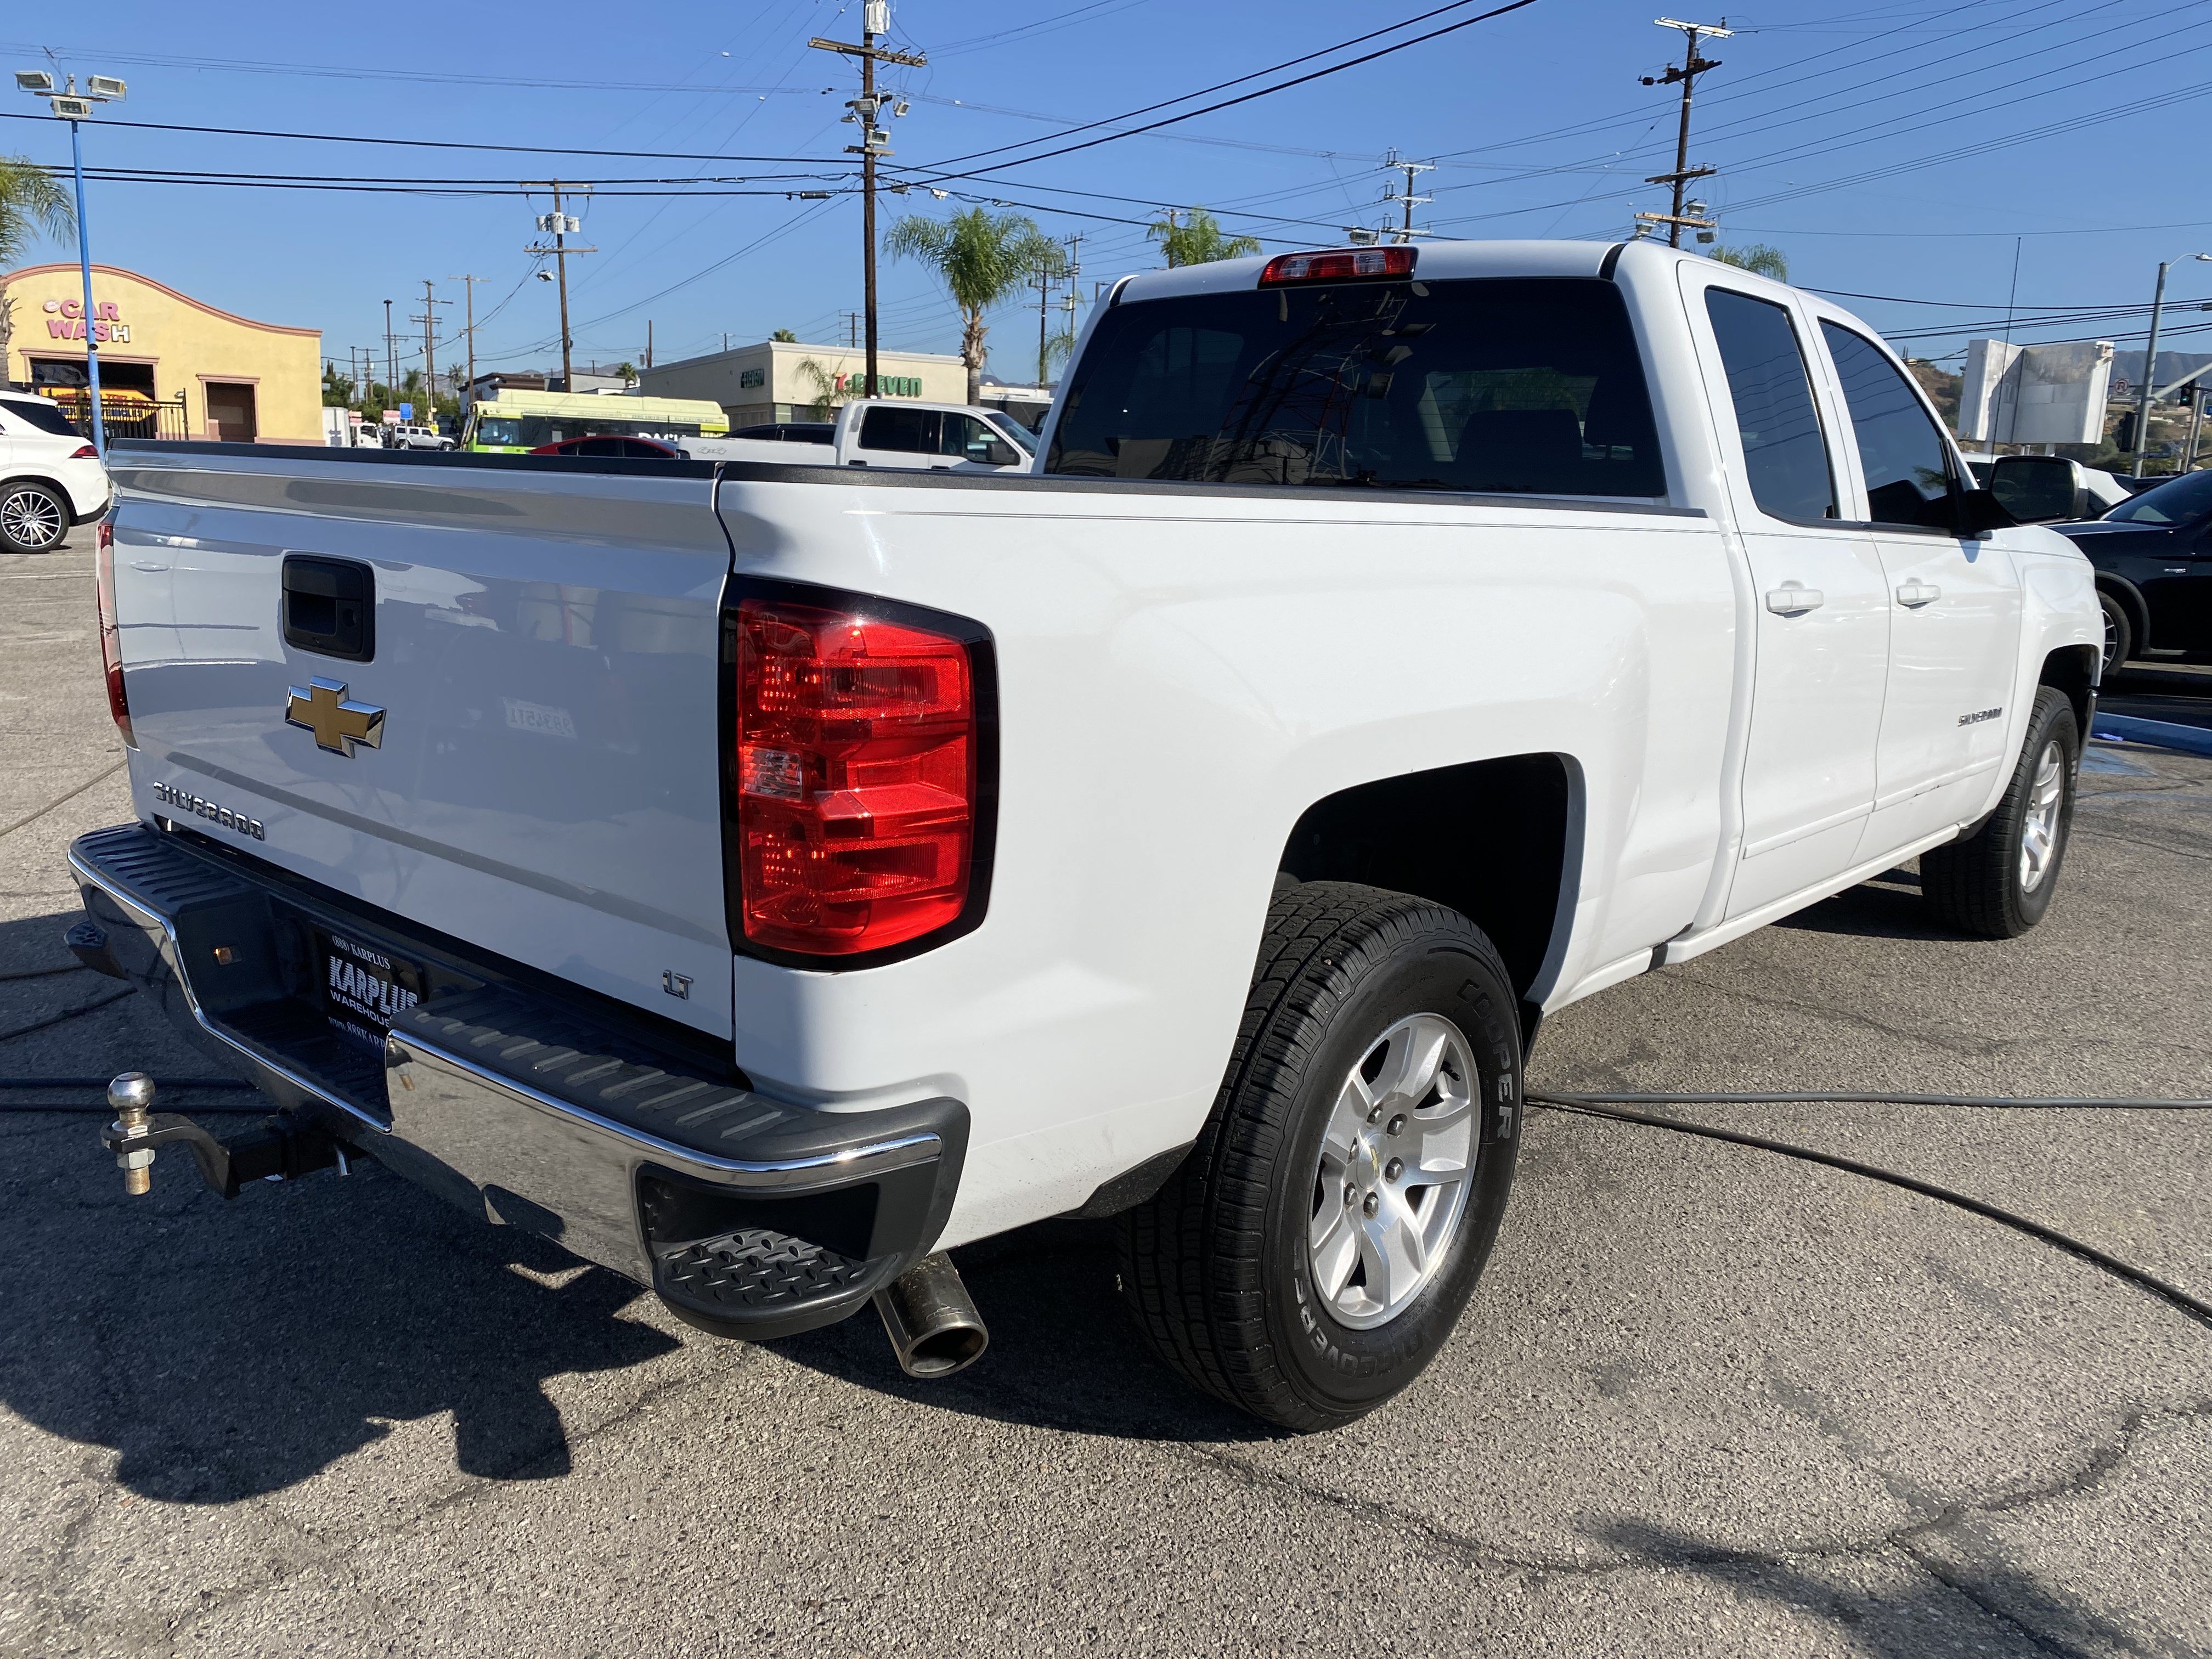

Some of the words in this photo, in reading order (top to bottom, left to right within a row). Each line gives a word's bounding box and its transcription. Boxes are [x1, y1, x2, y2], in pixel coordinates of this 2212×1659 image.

[47, 319, 131, 343] WASH
[153, 781, 265, 841] SILVERADO
[332, 934, 350, 952] (888)
[350, 943, 391, 970] KARPLUS
[663, 969, 693, 1000] LT
[1457, 979, 1514, 1139] COOPER
